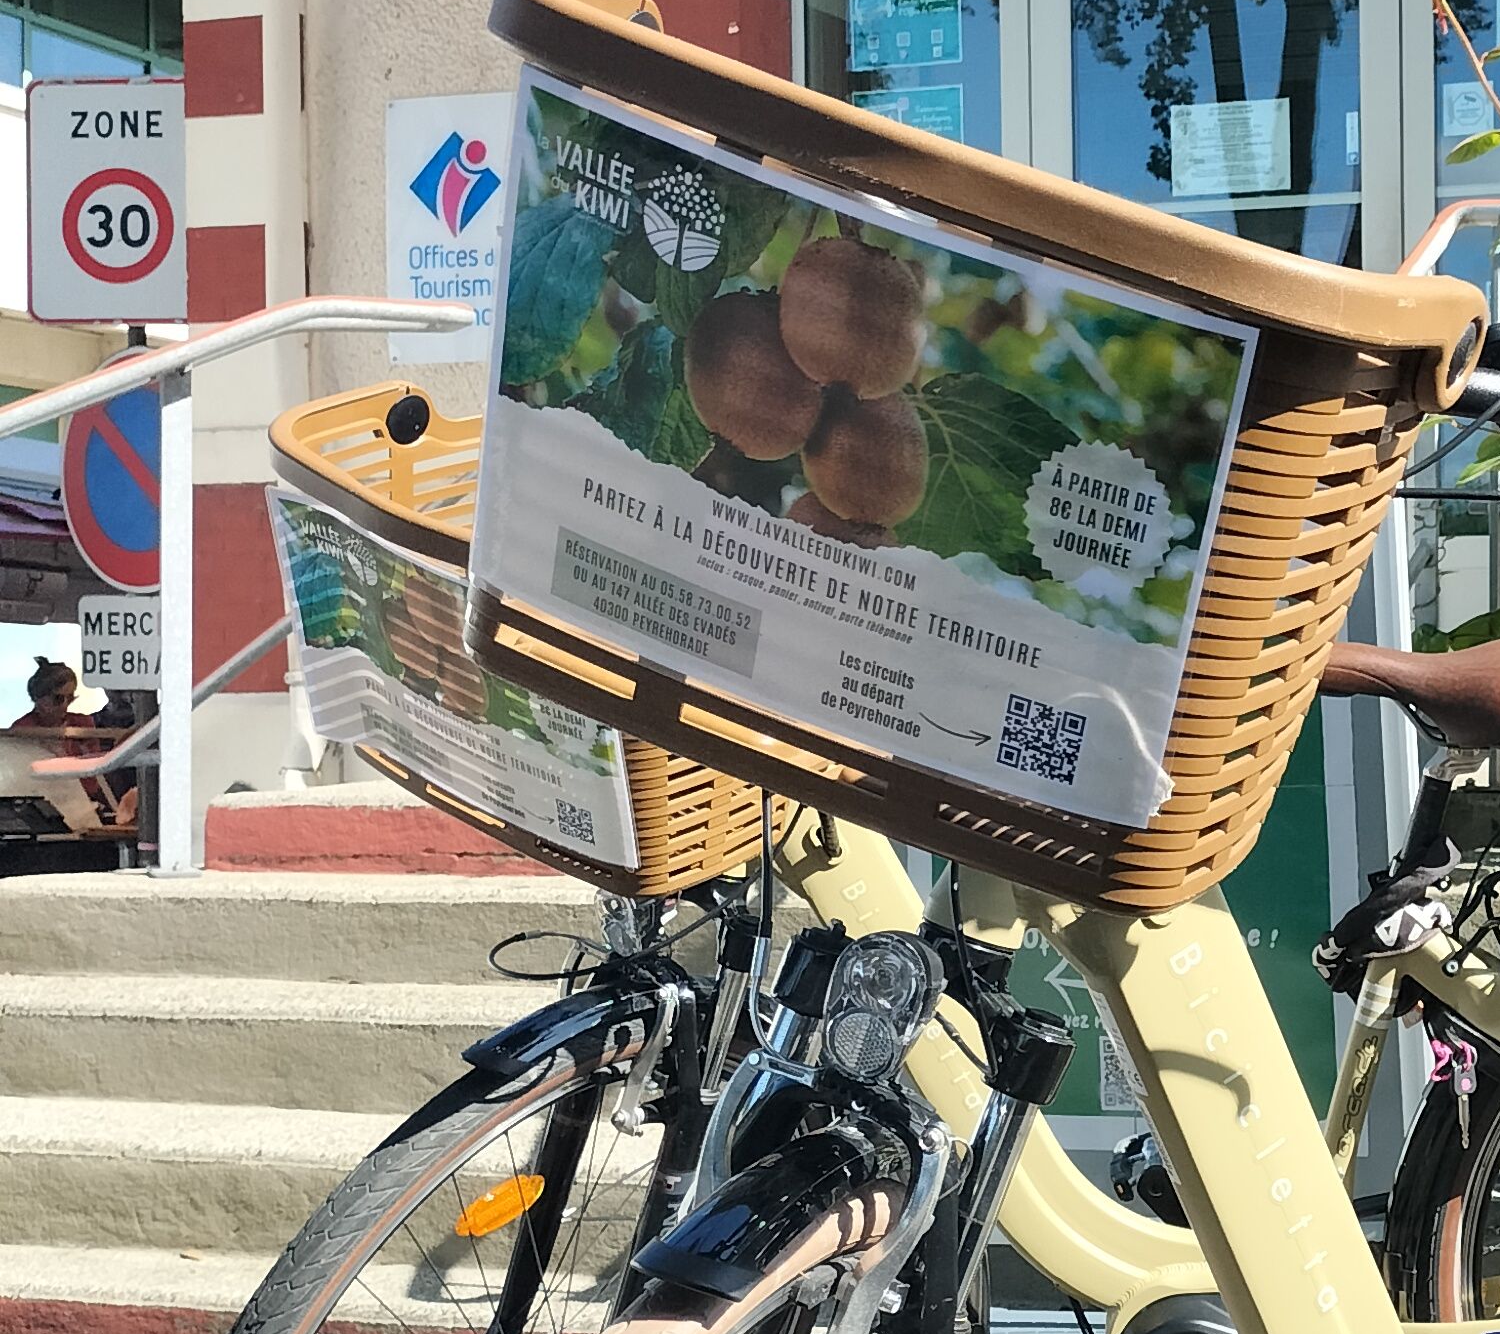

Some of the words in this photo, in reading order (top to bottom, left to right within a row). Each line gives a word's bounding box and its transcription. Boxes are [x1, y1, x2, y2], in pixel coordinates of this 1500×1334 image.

[71, 111, 163, 139] ZONE
[556, 135, 635, 196] VALLÉE
[551, 173, 570, 193] du
[574, 180, 630, 229] KIWI
[86, 204, 151, 249] 30
[409, 245, 478, 270] Offices
[485, 246, 494, 267] d
[410, 274, 495, 299] Tourism
[1051, 462, 1064, 488] À
[1068, 472, 1130, 508] PARTIR
[1134, 492, 1157, 516] DE
[1050, 497, 1072, 519] 8€
[1077, 505, 1096, 529] LA
[1102, 512, 1147, 543] DEMI
[316, 538, 345, 562] KIWI
[712, 499, 917, 592] WWW.LAVALLEEDUKIWI.COM
[1053, 529, 1132, 569] JOURNÉE
[565, 539, 637, 583] RÉSERVATION
[640, 573, 656, 591] AU
[660, 579, 752, 631] 05.58.73.00.52
[584, 478, 648, 523] PARTEZ
[653, 505, 664, 532] À
[673, 516, 693, 544] LA
[703, 529, 818, 593] DÉCOUVERTE
[826, 577, 849, 605] DE
[858, 589, 919, 630] NOTRE
[928, 613, 1043, 669] TERRITOIRE
[84, 611, 160, 638] MERC
[573, 565, 588, 583] OU
[591, 573, 607, 592] AU
[611, 581, 630, 601] 147
[633, 590, 665, 617] ALLÉE
[668, 604, 690, 627] DES
[693, 616, 736, 646] EVADÉS
[593, 596, 629, 623] 40300
[632, 612, 710, 658] PEYREHORADE
[83, 649, 114, 676] DE
[120, 648, 149, 675] 8h
[839, 650, 862, 672] Les
[863, 660, 915, 690] circuits
[821, 690, 838, 709] de
[839, 696, 922, 738] Peyrehorade
[841, 676, 858, 693] au
[861, 681, 905, 710] départ
[1168, 940, 1340, 1314] Bicicletta
